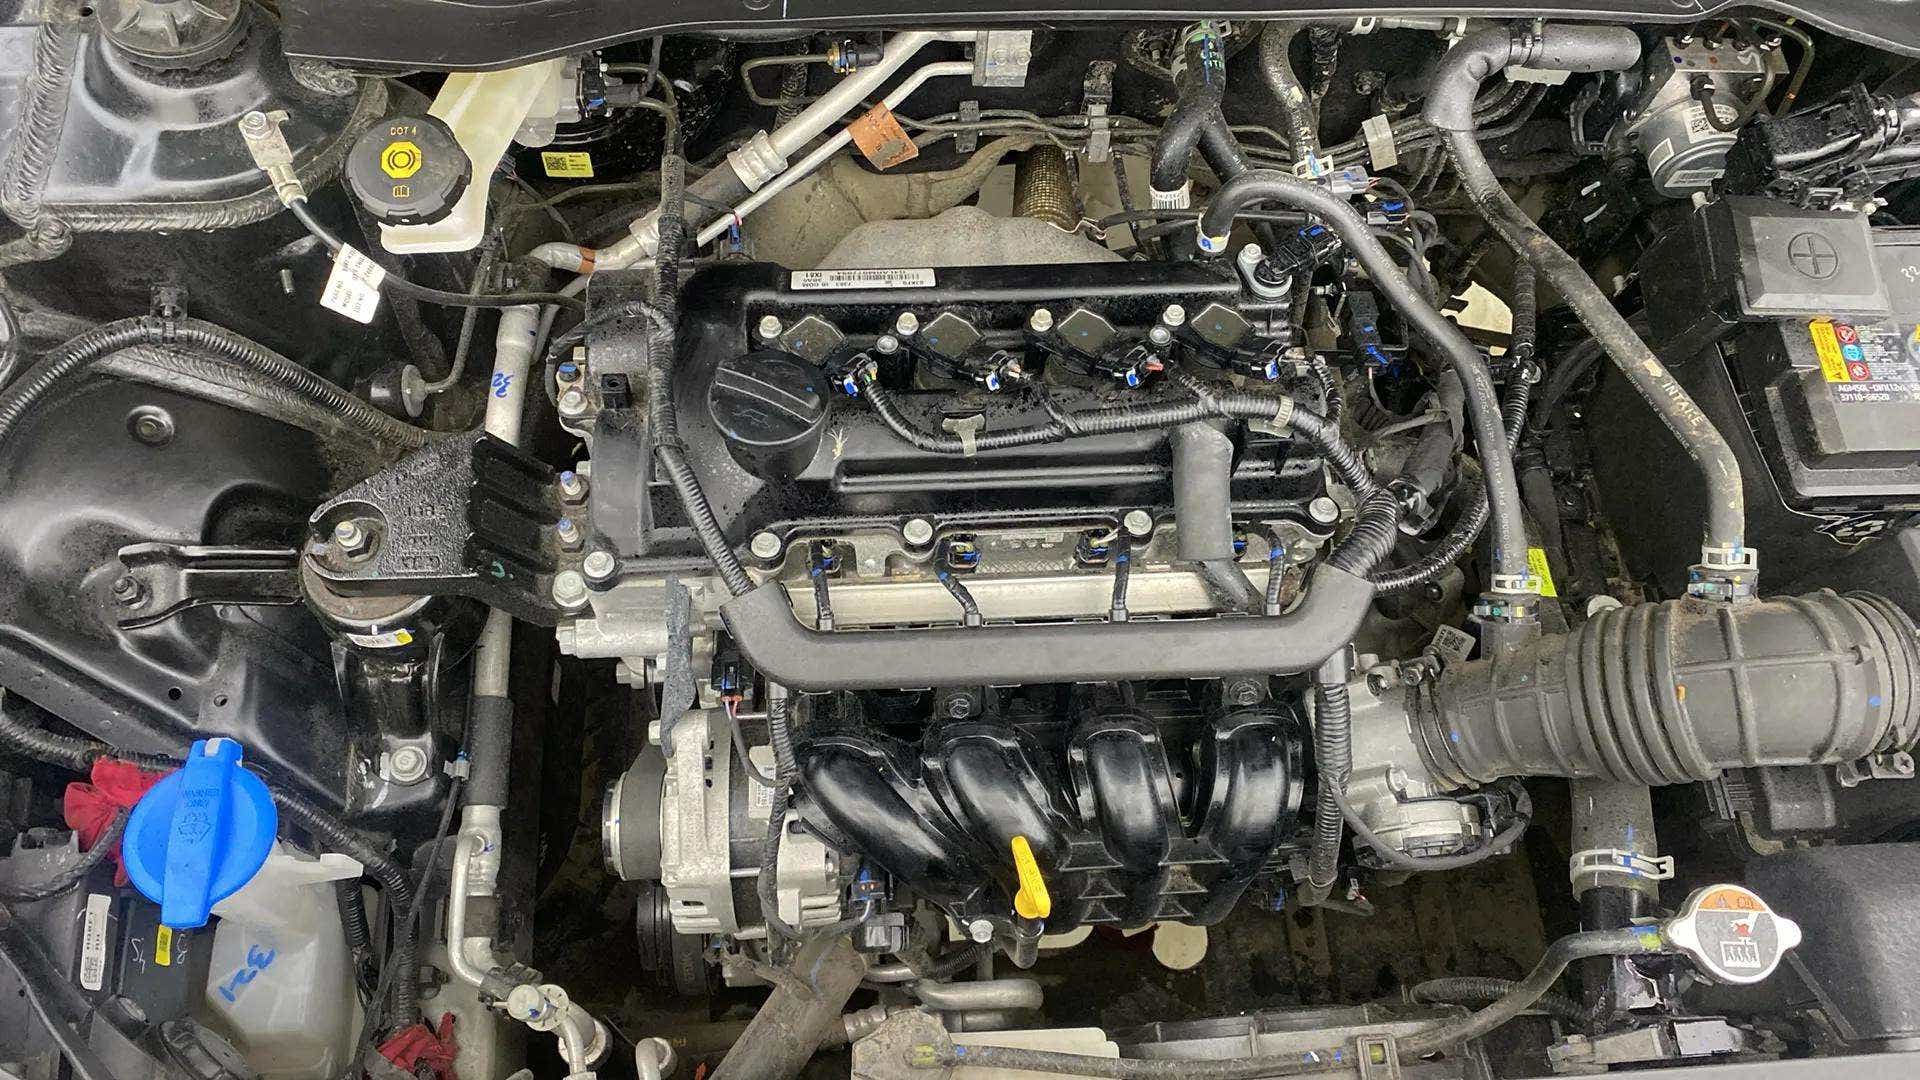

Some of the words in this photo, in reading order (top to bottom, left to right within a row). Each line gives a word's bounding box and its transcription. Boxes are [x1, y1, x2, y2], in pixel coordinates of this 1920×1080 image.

[390, 126, 409, 136] DOT
[411, 126, 417, 136] 4
[1661, 382, 1706, 427] INTAKE
